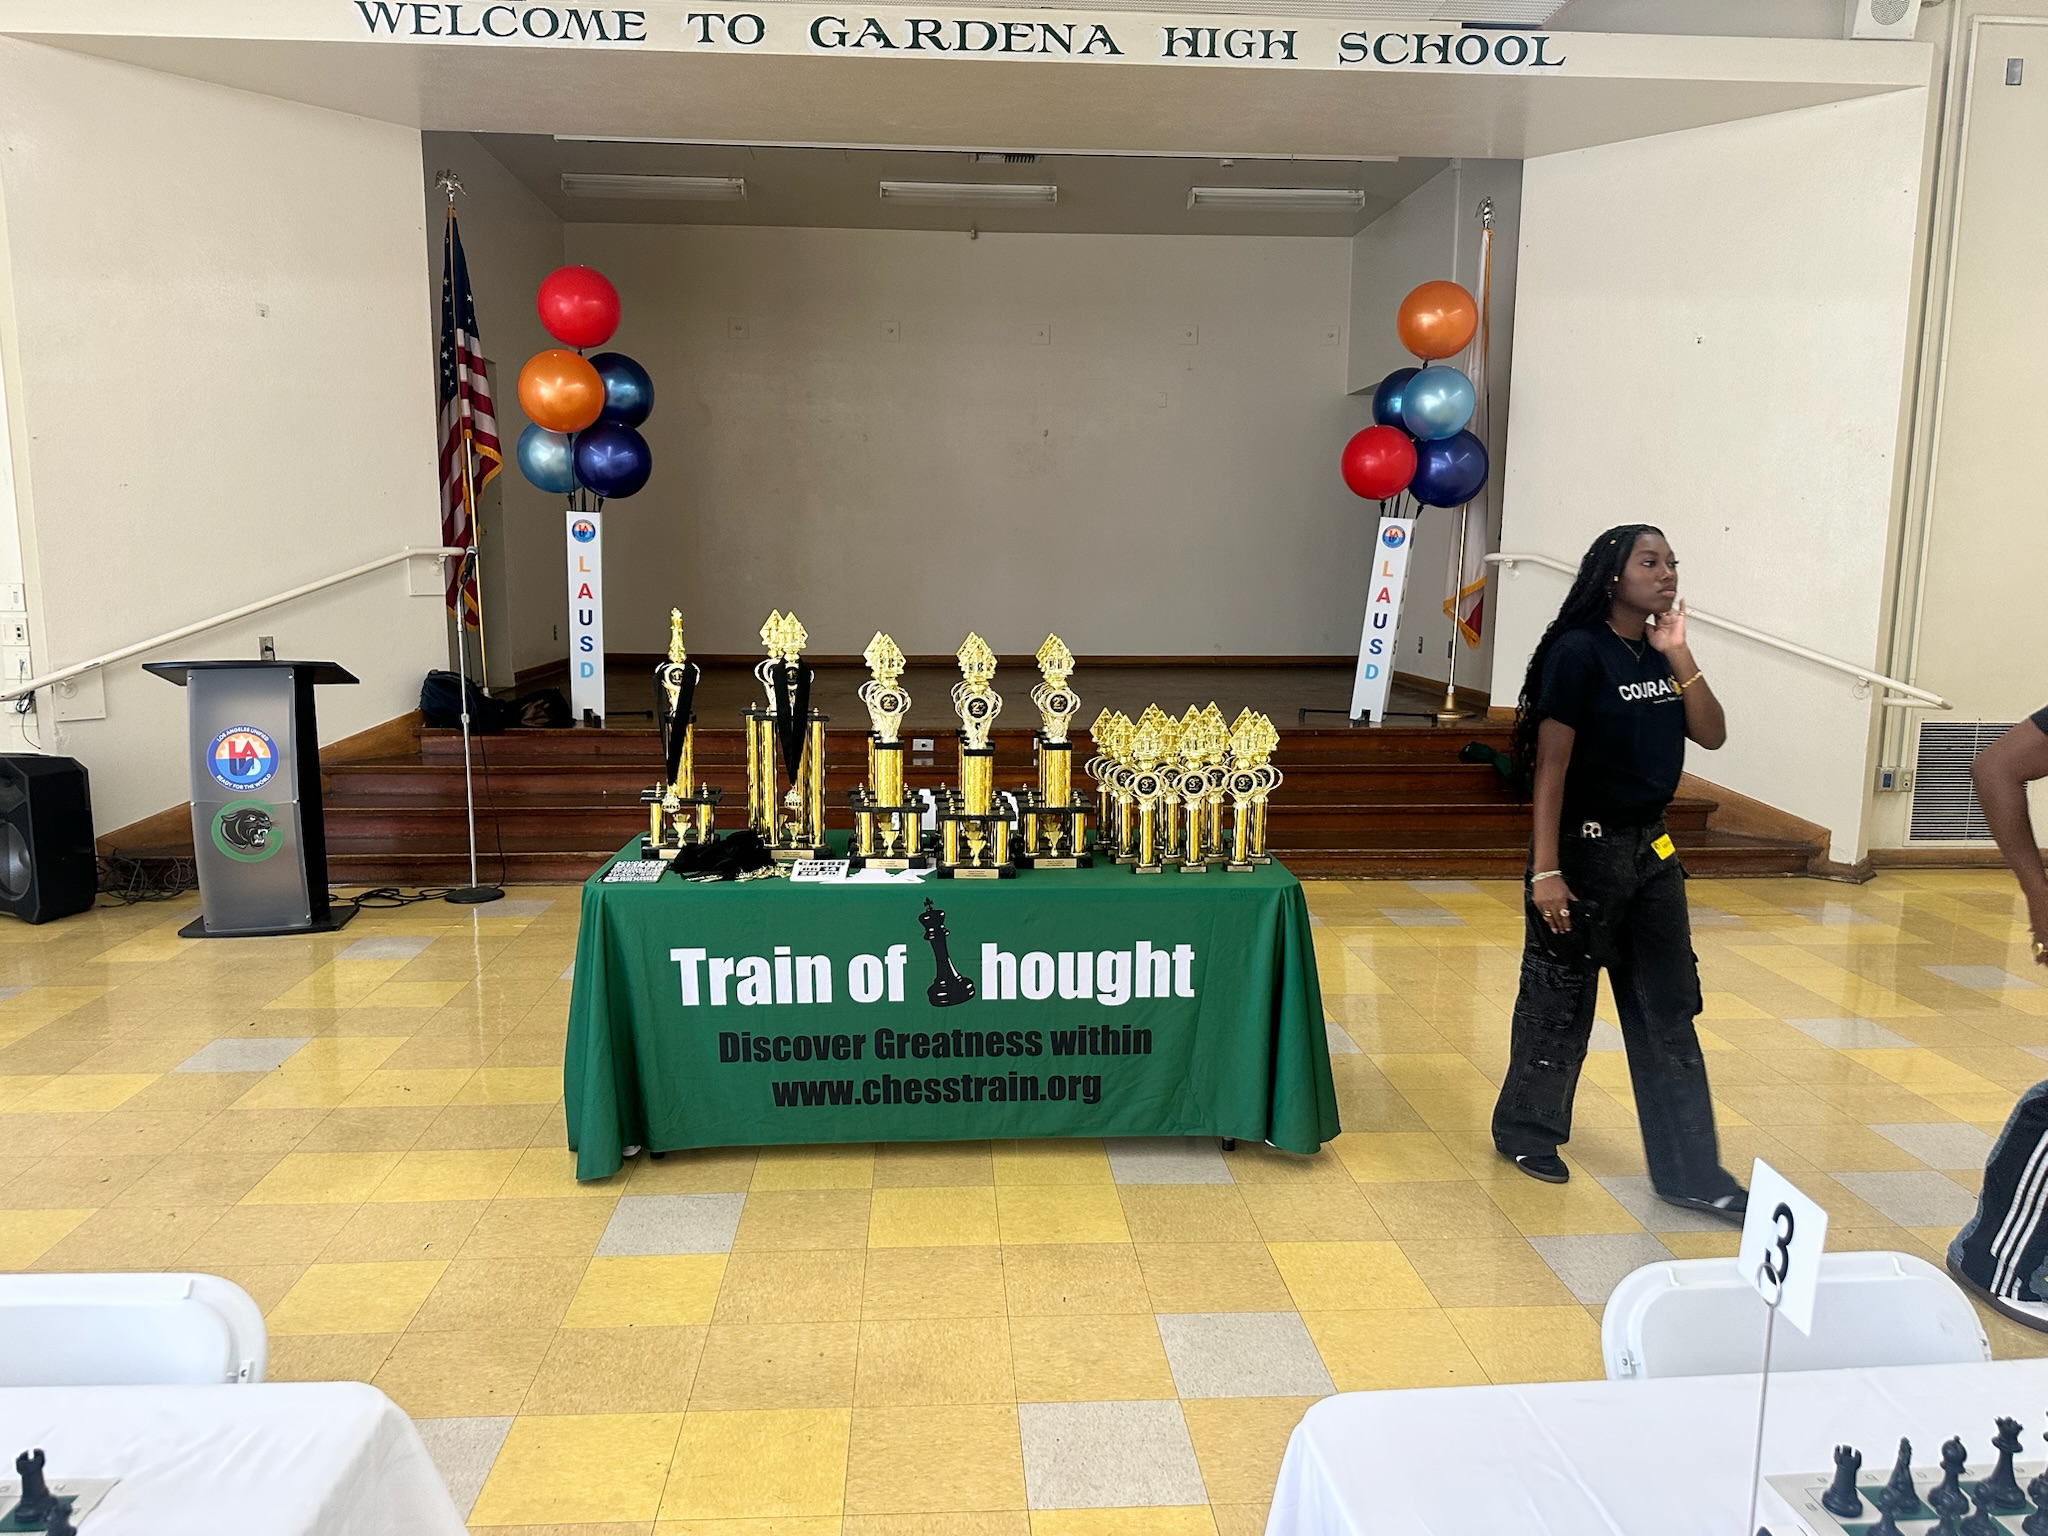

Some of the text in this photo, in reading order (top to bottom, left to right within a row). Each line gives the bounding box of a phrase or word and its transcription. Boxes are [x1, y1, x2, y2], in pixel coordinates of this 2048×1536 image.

[354, 0, 1567, 66] WELCOME TO GARDENA HIGH SCHOOL
[577, 556, 594, 678] LAUSD
[1364, 560, 1393, 680] LAUSD
[216, 733, 227, 742] LOS
[255, 773, 271, 787] WORLD
[670, 940, 1195, 1006] Train of hought
[719, 1024, 1153, 1063] Discover Greatness within
[772, 1070, 1101, 1107] www.chesstrain.org
[1765, 1202, 1794, 1286] 3
